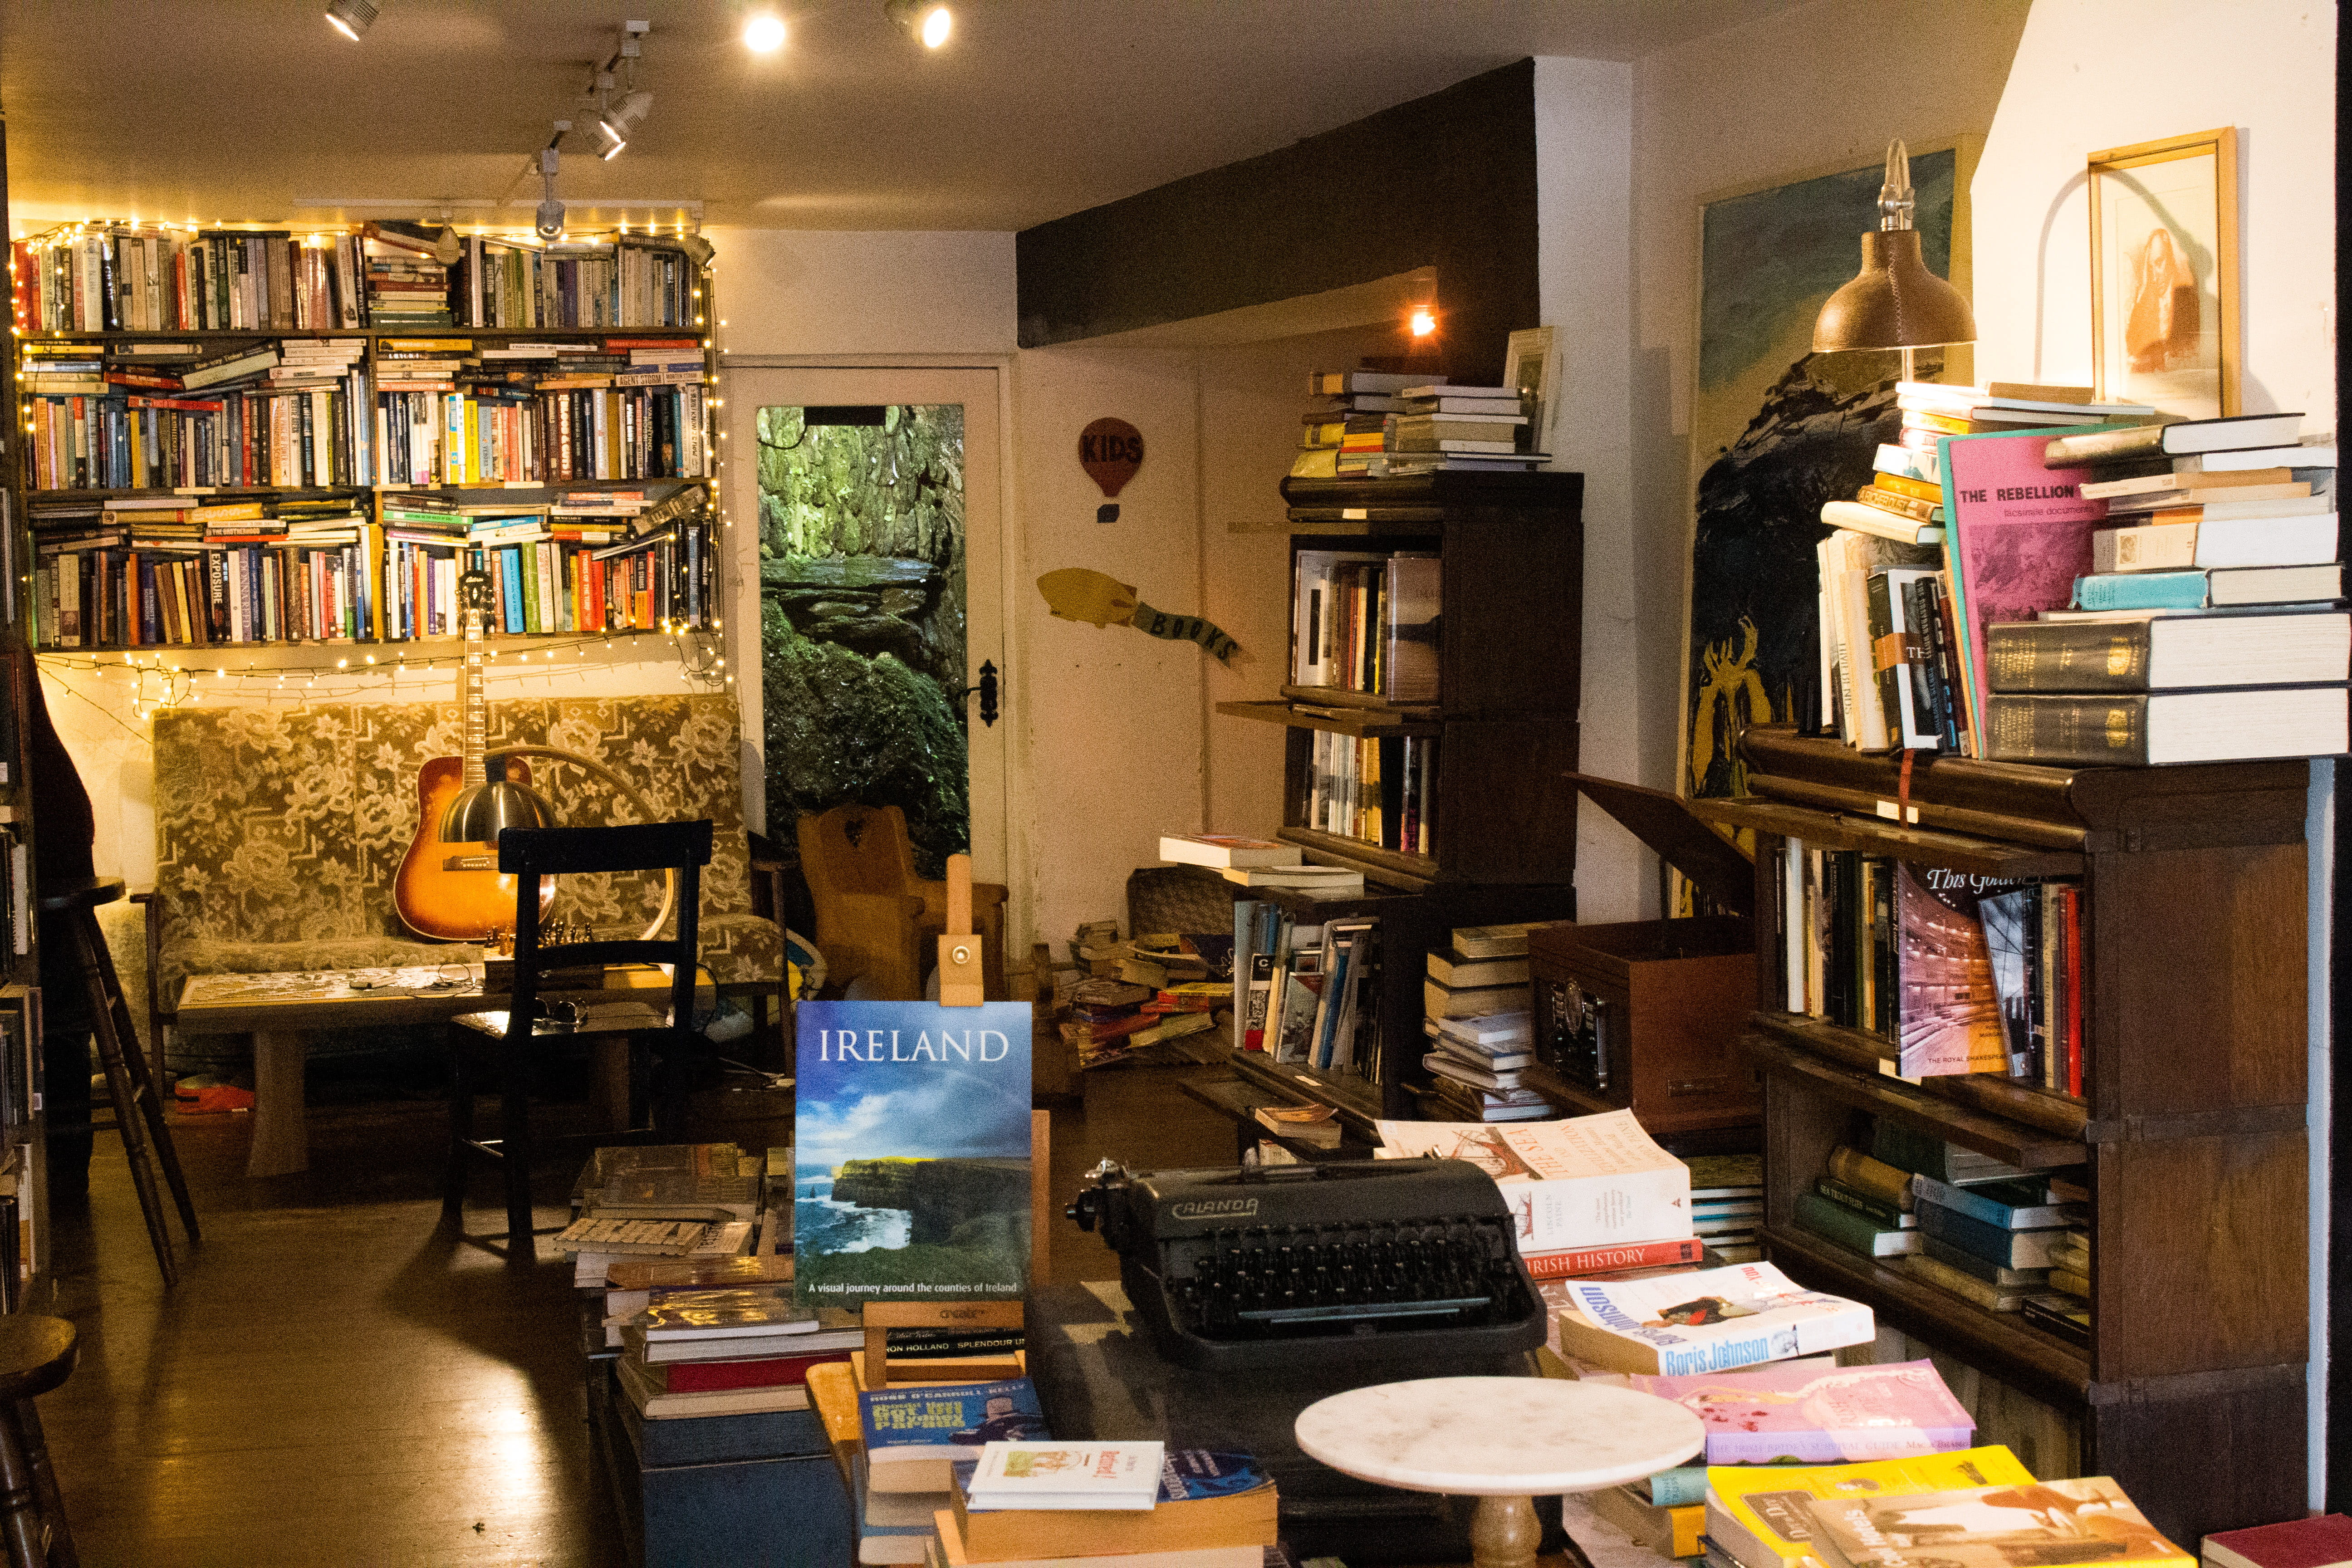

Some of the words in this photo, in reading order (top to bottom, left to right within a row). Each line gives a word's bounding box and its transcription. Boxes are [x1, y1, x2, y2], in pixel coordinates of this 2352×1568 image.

[620, 375, 639, 385] AGENT
[640, 374, 662, 384] STORM
[561, 401, 569, 435] BLOOD
[561, 435, 570, 444] &
[1083, 435, 1144, 463] KIDS
[561, 444, 570, 470] GUTS
[1960, 489, 1988, 504] THE
[1996, 485, 2075, 502] REBELLION
[211, 553, 222, 604] EXPOSURE
[240, 560, 249, 599] DONNA
[241, 602, 250, 628] REED
[1151, 612, 1239, 661] BOOKS
[1927, 868, 1967, 890] This
[819, 1029, 1009, 1063] IRELAND
[1966, 1053, 2006, 1061] SHAKESPEA
[1506, 1127, 1544, 1152] SEA
[1540, 1154, 1569, 1177] THE
[1526, 1257, 1570, 1274] IRISH
[1577, 1248, 1645, 1269] HISTORY
[808, 1283, 816, 1293] A
[818, 1283, 844, 1293] visual
[845, 1283, 881, 1295] journey
[883, 1283, 915, 1293] around
[917, 1283, 932, 1292] the
[934, 1283, 971, 1292] counties
[974, 1282, 984, 1292] of
[985, 1282, 1017, 1292] Ireland
[906, 1342, 949, 1352] HOLLAND
[957, 1339, 1012, 1349] SPLENDOUR
[1665, 1345, 1707, 1377] Boris
[1708, 1337, 1769, 1372] Johnson
[1865, 1440, 1900, 1450] GUIDE
